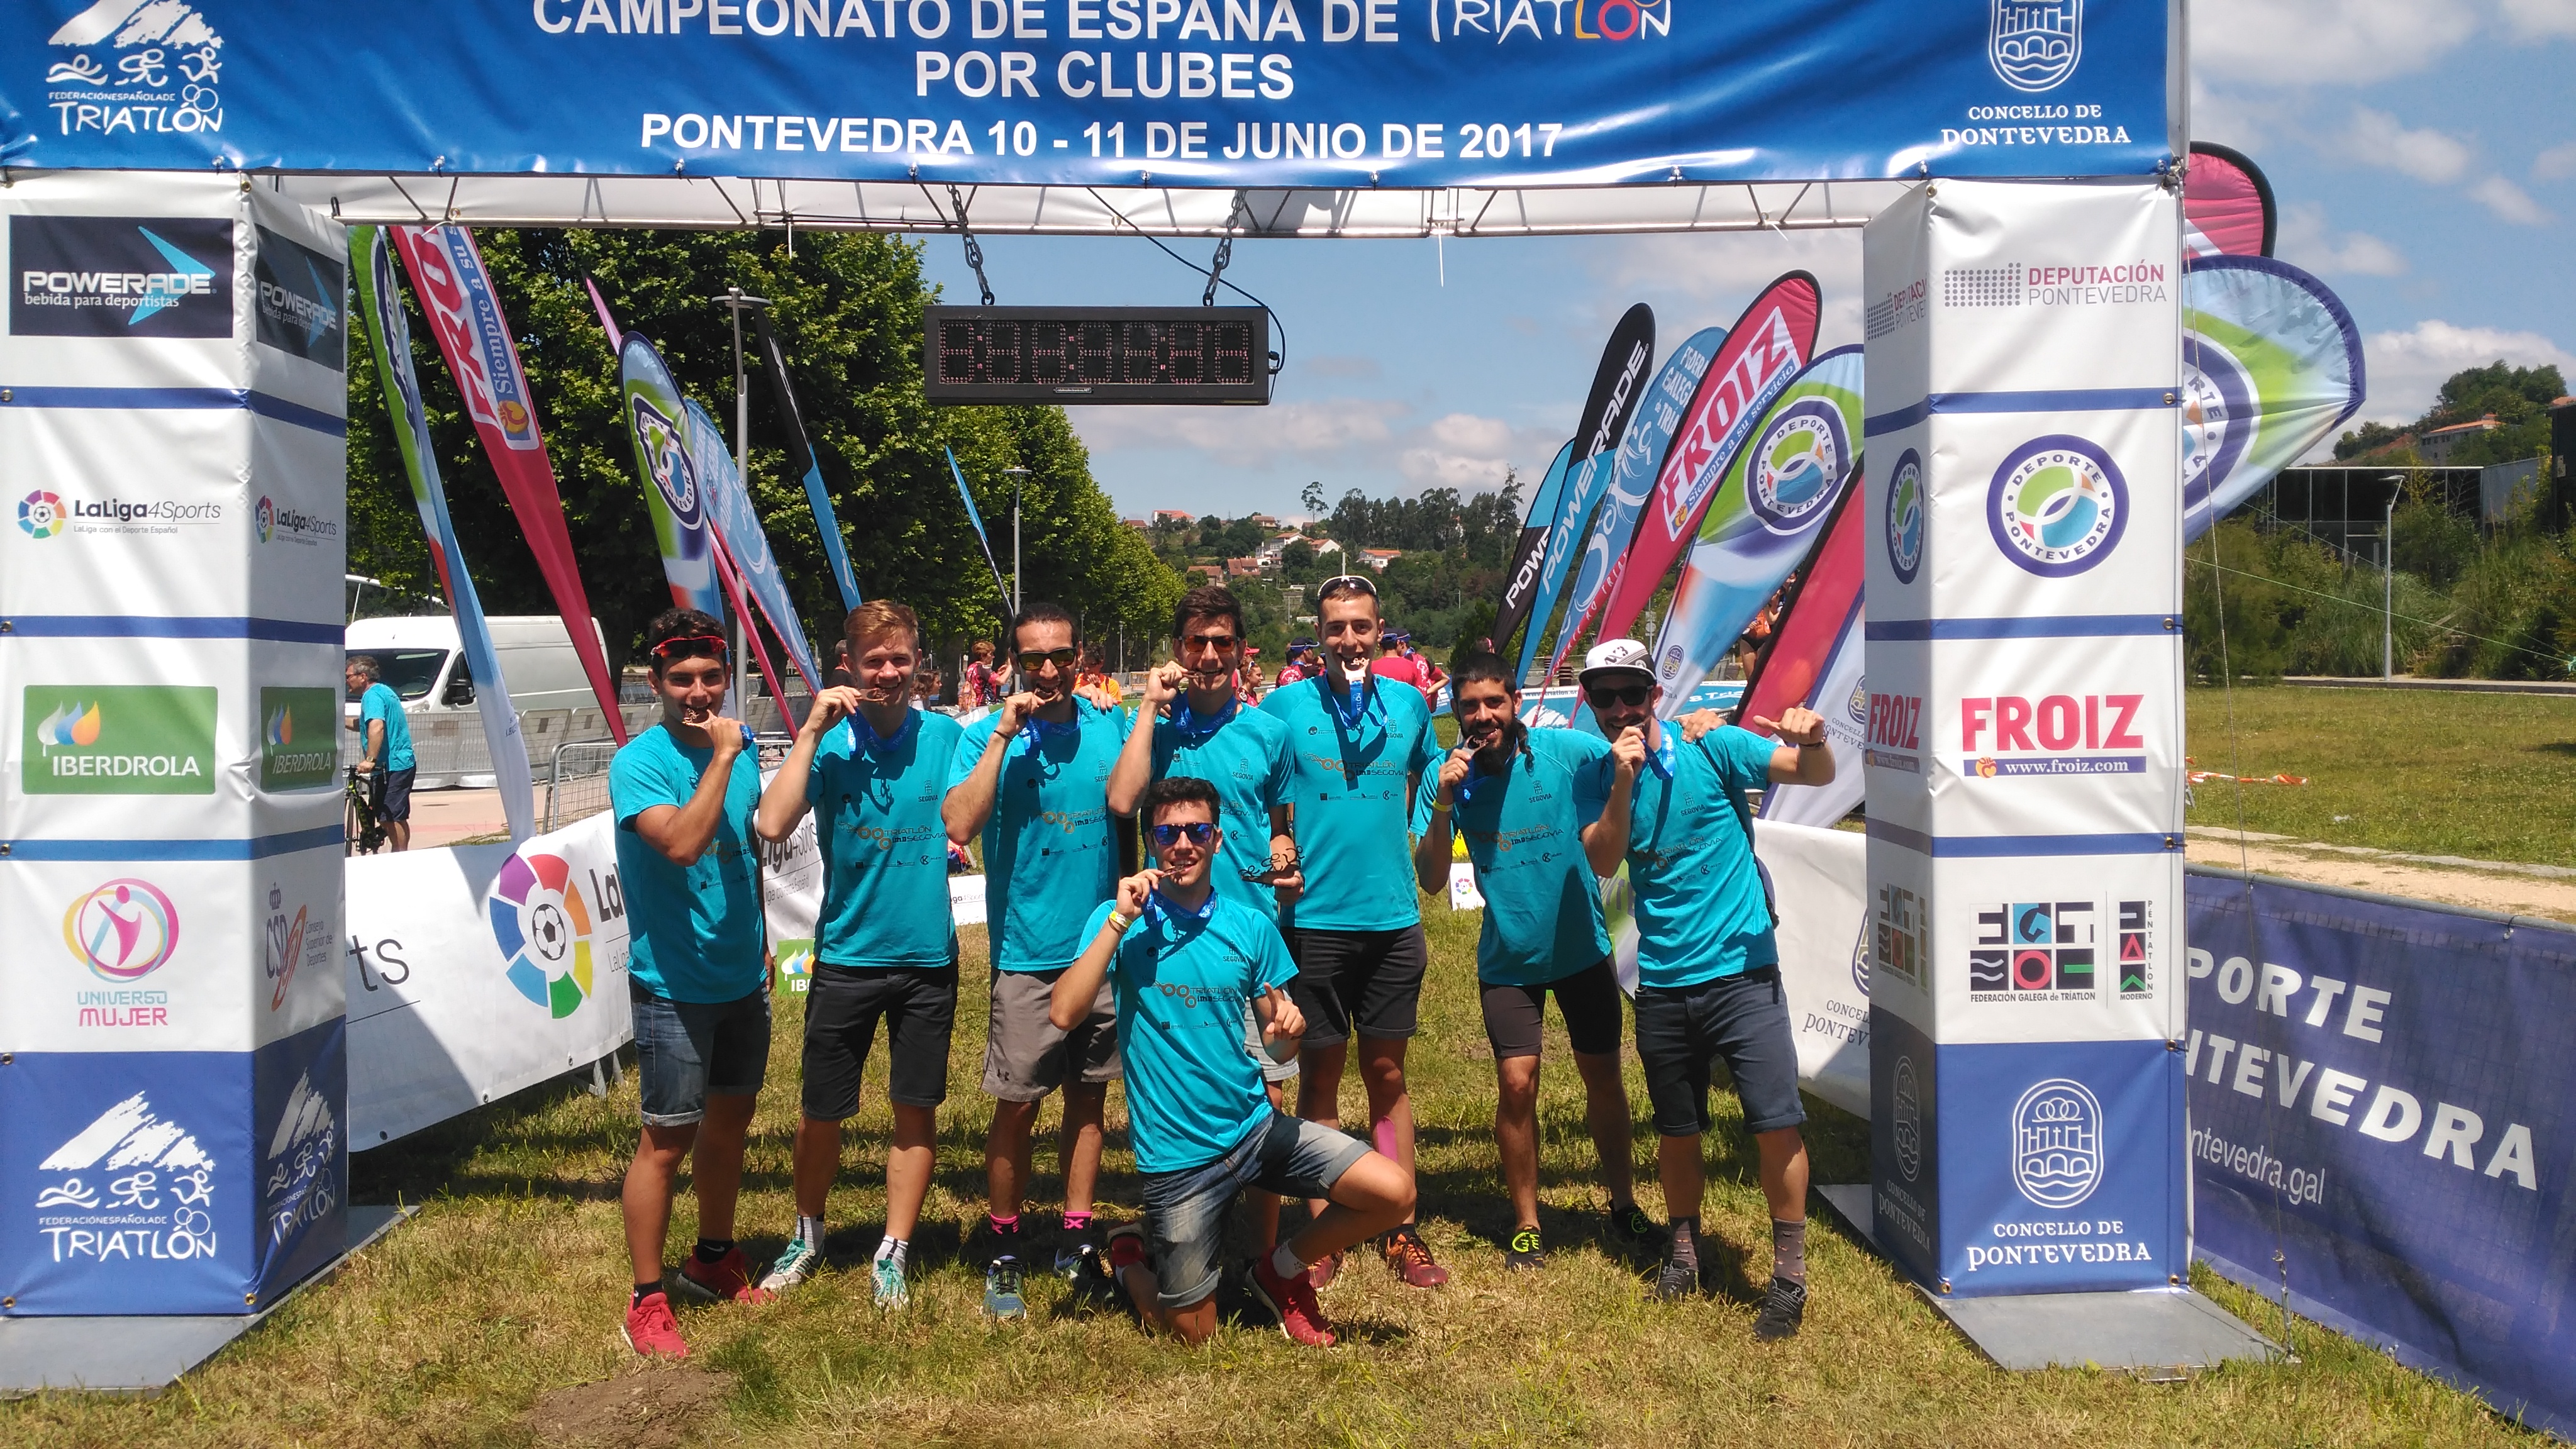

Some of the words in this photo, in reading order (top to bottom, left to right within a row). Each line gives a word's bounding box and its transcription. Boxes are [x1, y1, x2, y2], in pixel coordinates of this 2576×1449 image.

[534, 0, 951, 39] CAMPEONATO
[972, 0, 1047, 39] DE
[1323, 0, 1399, 42] DE
[918, 51, 1040, 98] POR
[1057, 51, 1294, 101] CLUBES
[1968, 105, 2069, 120] CONCELLO
[2075, 104, 2102, 119] DE
[641, 113, 974, 156] PONTEVEDRA
[988, 120, 1037, 157] 10
[1083, 121, 1126, 158] 11
[1146, 122, 1208, 159] DE
[1223, 122, 1367, 160] JUNIO
[1384, 123, 1444, 159] DE
[1459, 122, 1563, 159] 2017
[1941, 125, 2132, 149] PONTEVEDRA
[454, 244, 474, 270] su
[23, 272, 213, 296] POWERADE
[470, 277, 484, 291] a
[2028, 259, 2165, 286] DEPUTACIÓN
[24, 291, 70, 307] bebida
[74, 296, 103, 309] para
[105, 292, 180, 309] deportistas
[260, 280, 337, 330] POWERADE
[2029, 285, 2167, 306] PONTEVEDRA
[283, 313, 298, 324] para
[413, 226, 498, 424] FRO
[479, 299, 514, 394] Siempre
[1663, 314, 1789, 517] FROIZ
[1687, 450, 1727, 506] Siempre
[1727, 438, 1735, 450] a
[1736, 419, 1750, 439] su
[1751, 364, 1794, 418] servicio
[1777, 419, 1833, 454] DEPORTE
[1542, 340, 1648, 596] POWERADE
[2012, 453, 2102, 487] DEPORTE
[1759, 460, 1834, 515] PONTEVEDRA
[74, 499, 221, 523] LaLiga4Sports
[277, 508, 336, 536] LaLiga4Sports
[74, 525, 97, 534] LaLiga
[123, 526, 148, 534] Deporte
[151, 526, 178, 534] Español
[2006, 507, 2111, 560] PONTEVEDRA
[1867, 693, 1922, 750] FROIZ
[1962, 693, 2145, 752] FROIZ
[53, 755, 201, 777] IBERDROLA
[272, 752, 332, 775] IBERDROLA
[1232, 770, 1254, 781] SEGOVIA
[2005, 758, 2129, 775] www.froiz.com
[918, 794, 939, 802] SEGOVIA
[1529, 793, 1552, 803] SEGOVIA
[1680, 803, 1706, 817] SEGOVIA
[306, 919, 324, 935] Consejo
[266, 914, 289, 979] CSD
[306, 935, 325, 951] Superior
[326, 931, 333, 945] de
[306, 951, 326, 969] Deportes
[77, 990, 168, 1005] UNIVERSO
[1970, 991, 2016, 1002] FEDERACIÓN
[2018, 993, 2048, 1002] GALEGA
[2050, 992, 2059, 1001] de
[2119, 992, 2153, 1001] MODERNO
[79, 1007, 169, 1028] MUJER
[2191, 1128, 2325, 1206] ntevedra.gal
[1887, 1179, 1917, 1214] CONCELLO
[1917, 1206, 1926, 1222] DE
[1878, 1192, 1931, 1256] PONTEVEDRA
[1993, 1222, 2091, 1238] CONCELLO
[2097, 1220, 2123, 1235] DE
[39, 1226, 216, 1262] TRIATLÓN
[1967, 1243, 2152, 1272] PONTEVEDRA
